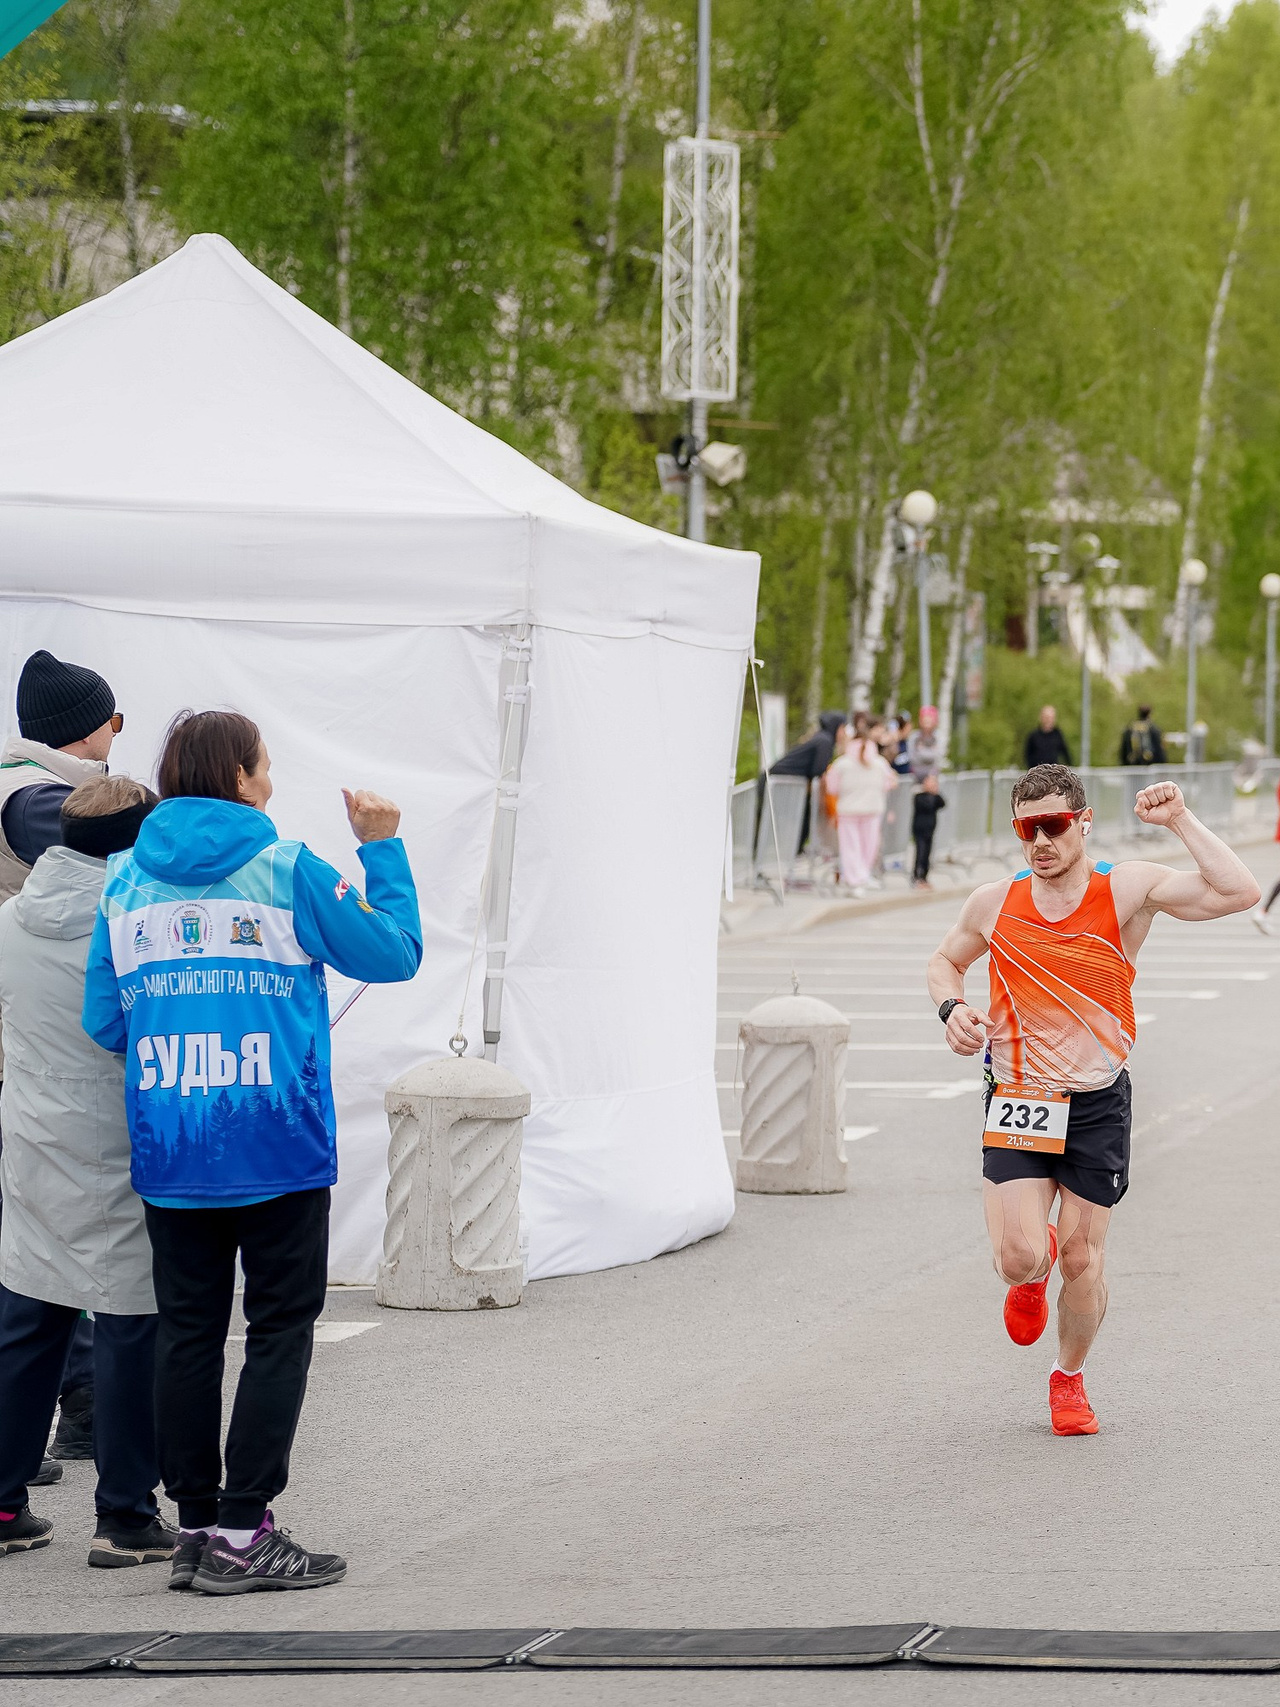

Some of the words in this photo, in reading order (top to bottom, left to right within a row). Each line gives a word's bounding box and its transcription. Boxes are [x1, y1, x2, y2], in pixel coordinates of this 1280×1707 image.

[136, 1032, 273, 1097] СУДЬЯ
[999, 1103, 1050, 1131] 232
[1006, 1135, 1023, 1147] 21,1
